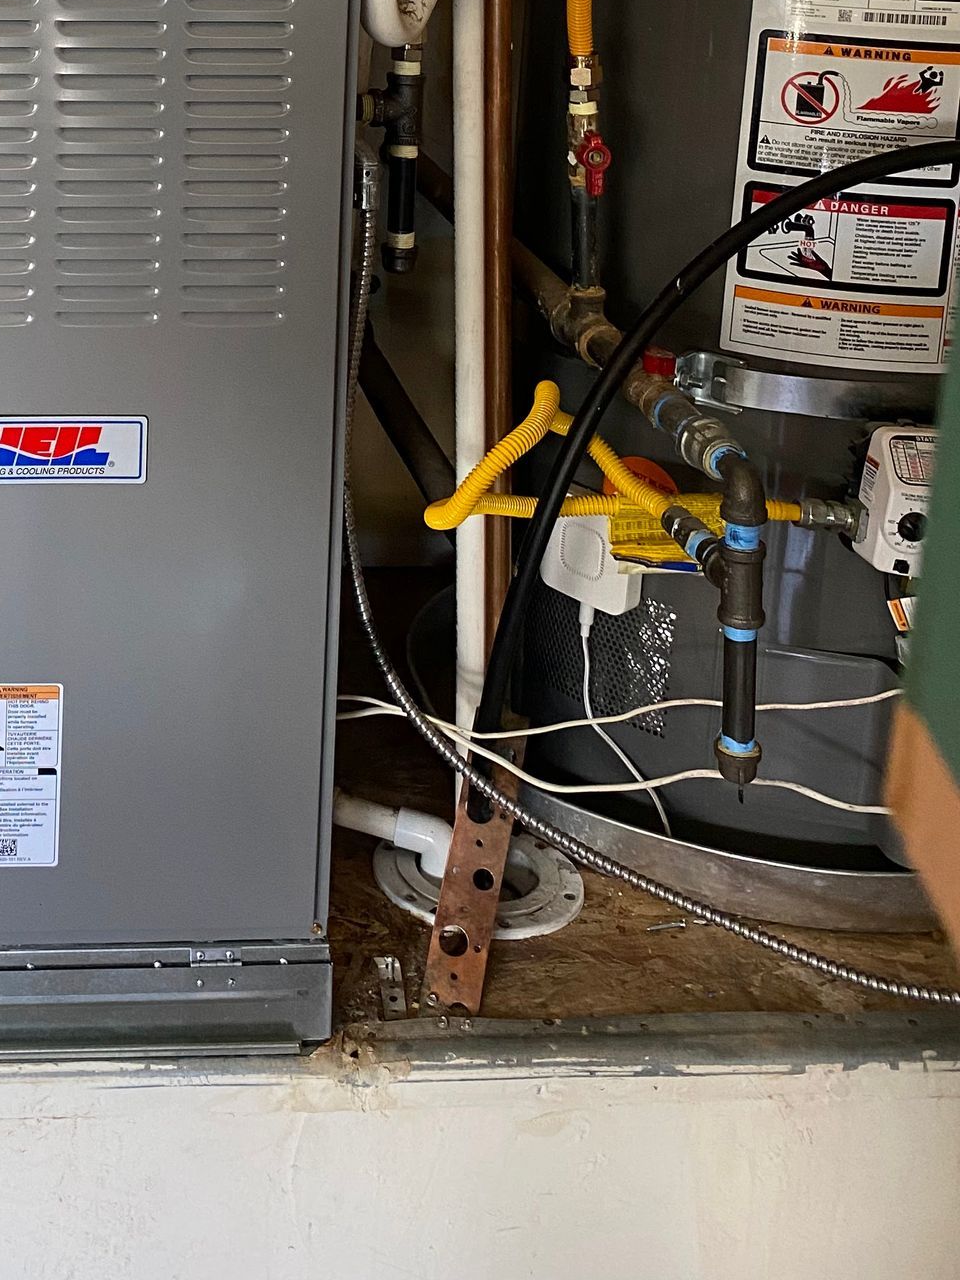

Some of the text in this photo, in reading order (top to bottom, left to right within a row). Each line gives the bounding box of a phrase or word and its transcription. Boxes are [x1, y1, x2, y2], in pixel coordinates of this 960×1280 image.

[841, 47, 912, 61] WARNING
[857, 115, 920, 126] Flammable Vapors
[842, 131, 879, 141] EXPLOSION
[868, 141, 883, 149] injury
[830, 201, 889, 215] DANGER
[800, 240, 817, 248] HOT
[820, 300, 880, 314] WARNING
[16, 467, 55, 475] COOLING
[57, 467, 105, 475] PRODUCTS
